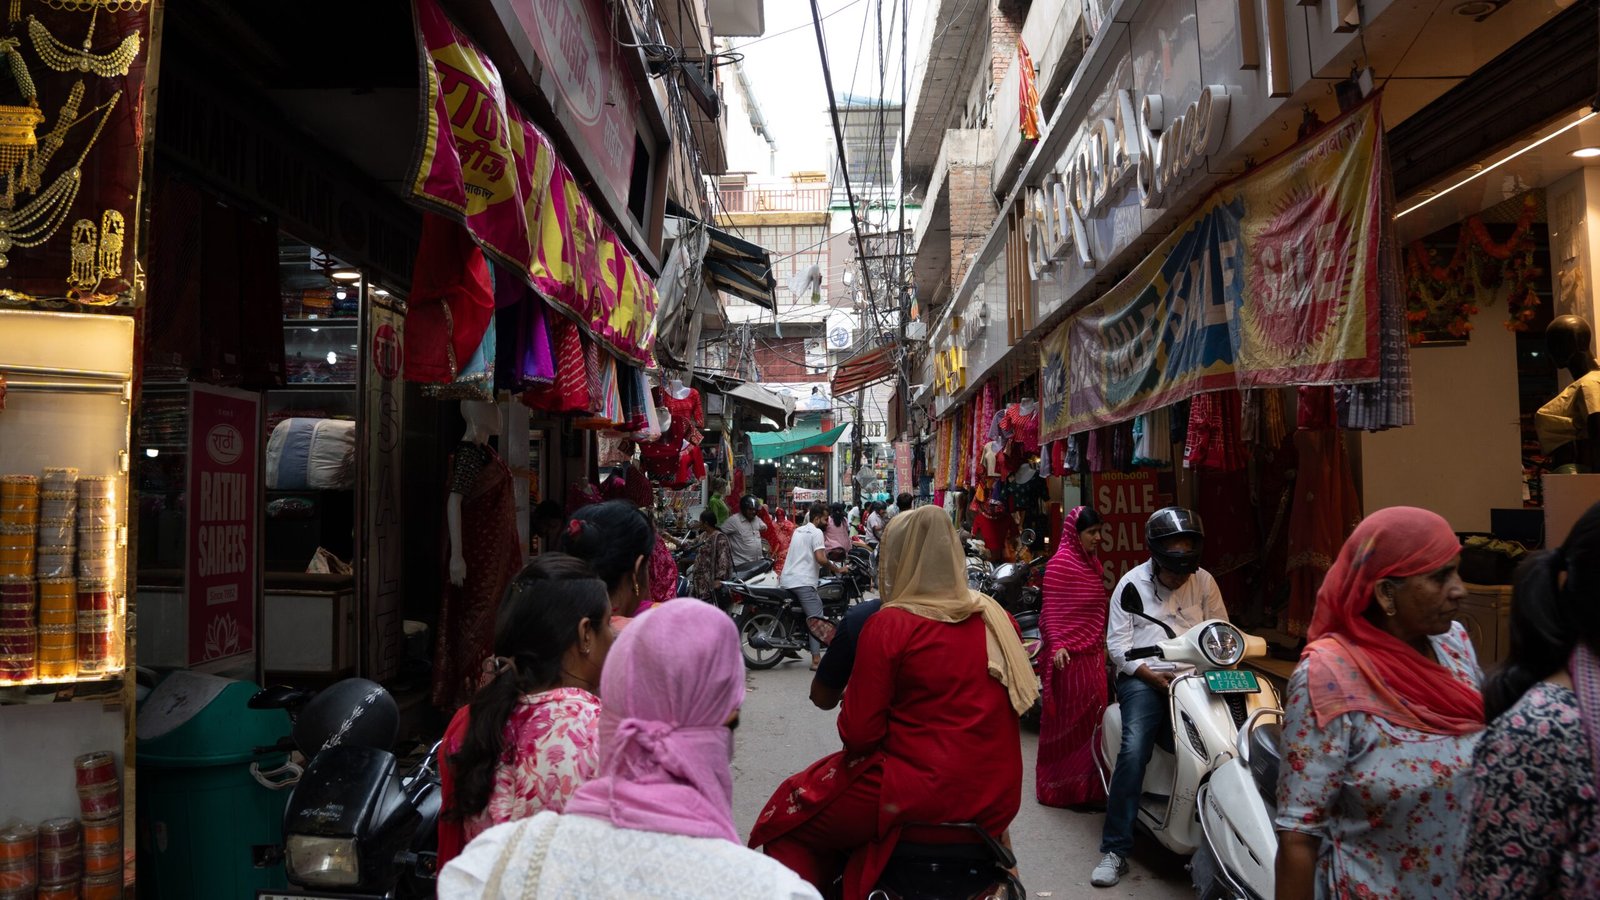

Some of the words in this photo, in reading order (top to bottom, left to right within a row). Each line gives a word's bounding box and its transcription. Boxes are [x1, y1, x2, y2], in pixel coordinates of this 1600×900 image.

[1170, 239, 1237, 343] SALE
[1261, 223, 1336, 315] SALE
[200, 471, 247, 521] RATHI
[1098, 484, 1155, 515] SALE
[198, 524, 247, 577] SAREES
[1100, 521, 1146, 553] SAL
